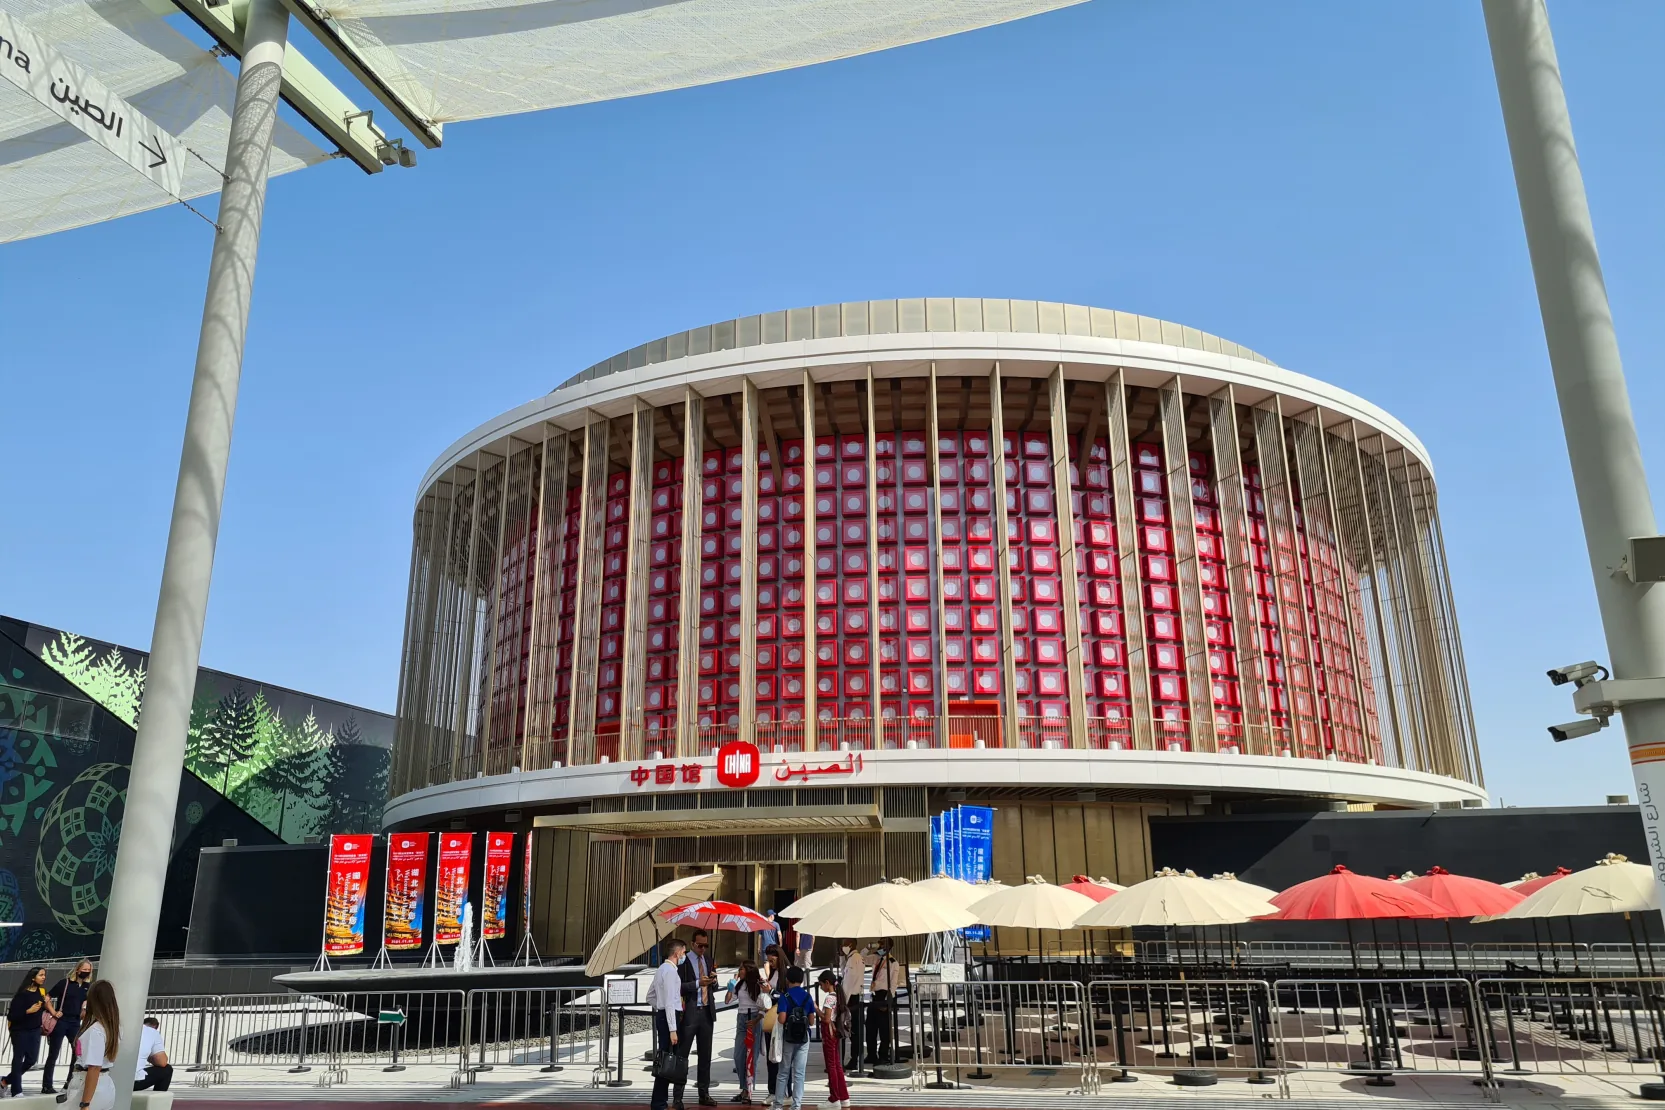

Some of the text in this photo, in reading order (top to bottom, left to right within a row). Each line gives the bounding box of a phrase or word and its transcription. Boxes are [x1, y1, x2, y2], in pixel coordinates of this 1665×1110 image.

[50, 77, 123, 138] الصين
[630, 762, 703, 787] 中国馆
[724, 749, 751, 779] CHINA
[775, 752, 863, 782] الصين
[1639, 782, 1660, 822] شارع
